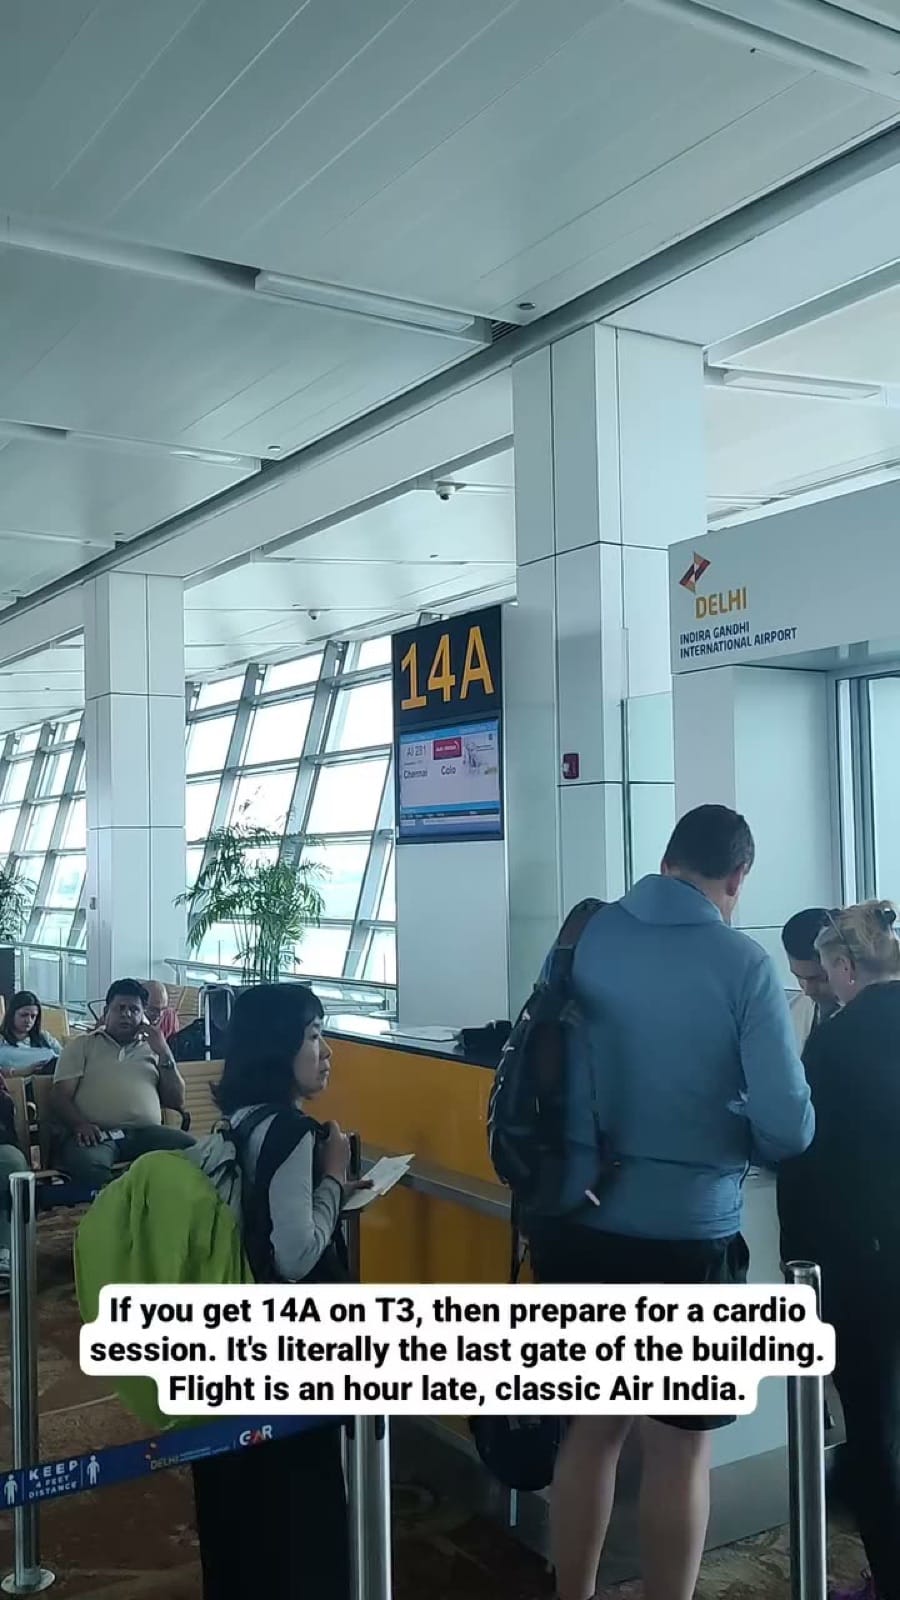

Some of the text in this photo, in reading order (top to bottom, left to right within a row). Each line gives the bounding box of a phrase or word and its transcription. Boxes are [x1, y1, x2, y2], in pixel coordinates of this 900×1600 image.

[695, 586, 747, 619] DELHI
[680, 621, 750, 645] INDIRA GANDHI
[680, 627, 798, 659] INTERNATIONAL AIRPORT
[400, 625, 495, 711] 14A
[29, 1460, 79, 1481] KEEP
[151, 1455, 179, 1470] DELHI
[28, 1481, 77, 1499] DISTANCE
[45, 1475, 70, 1486] FEET
